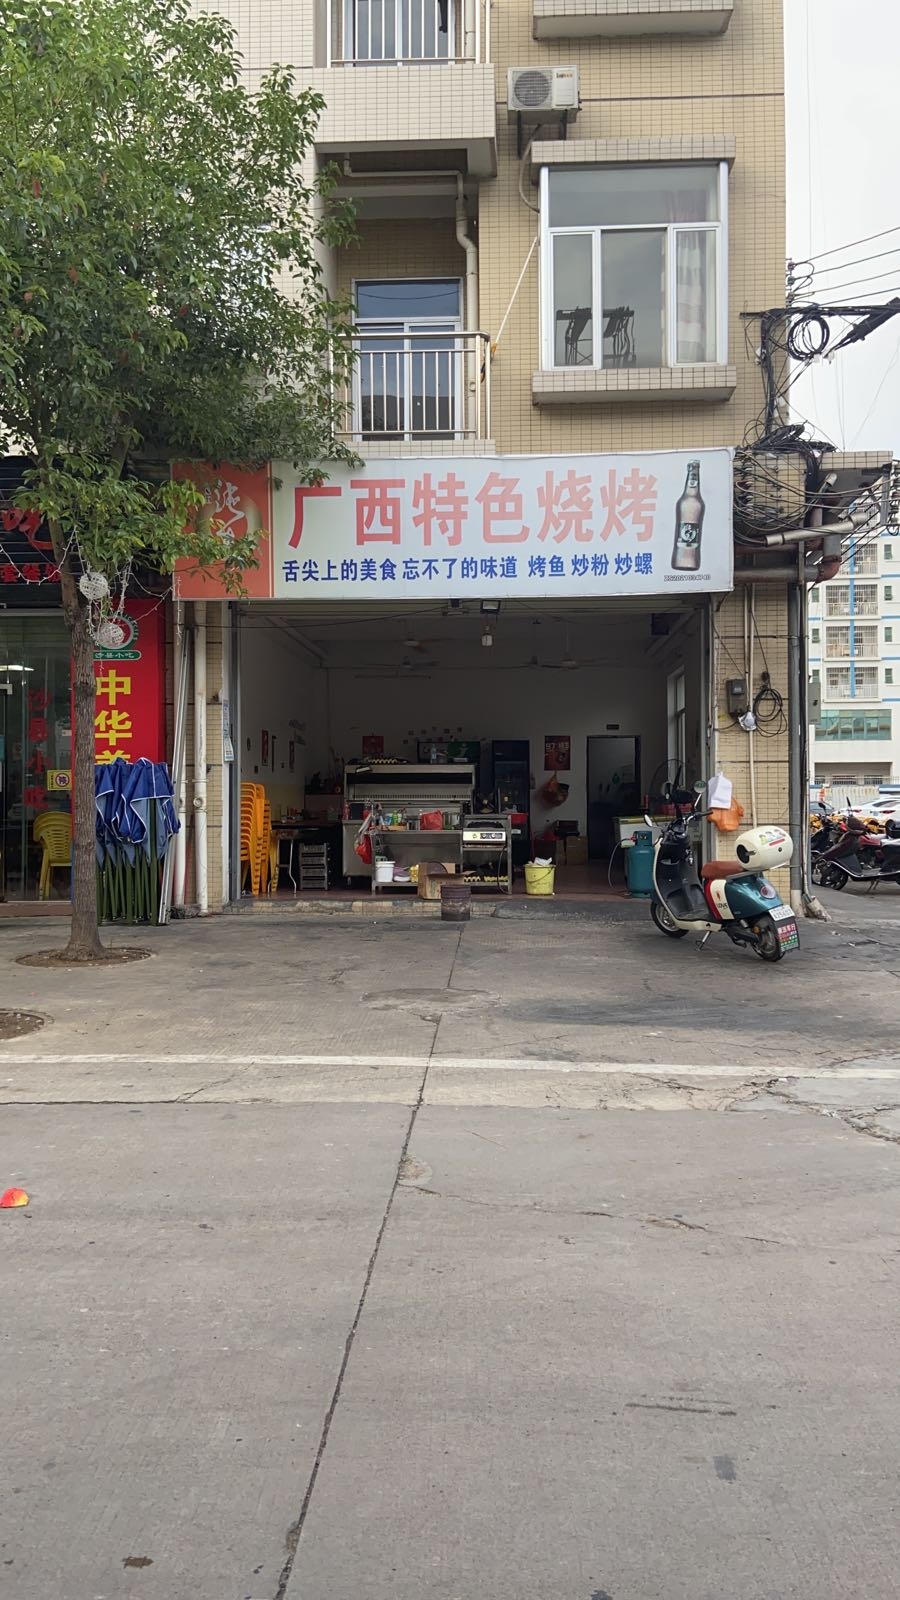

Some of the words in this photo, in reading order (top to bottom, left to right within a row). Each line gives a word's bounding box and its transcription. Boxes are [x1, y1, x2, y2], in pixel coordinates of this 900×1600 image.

[288, 467, 658, 549] 广西特色烧烤
[282, 557, 397, 583] 舌尖上的美食
[402, 555, 518, 582] 忘不了的味道
[528, 554, 566, 578] 烤鱼
[571, 552, 609, 577] 炒粉
[614, 552, 653, 576] 炒螺
